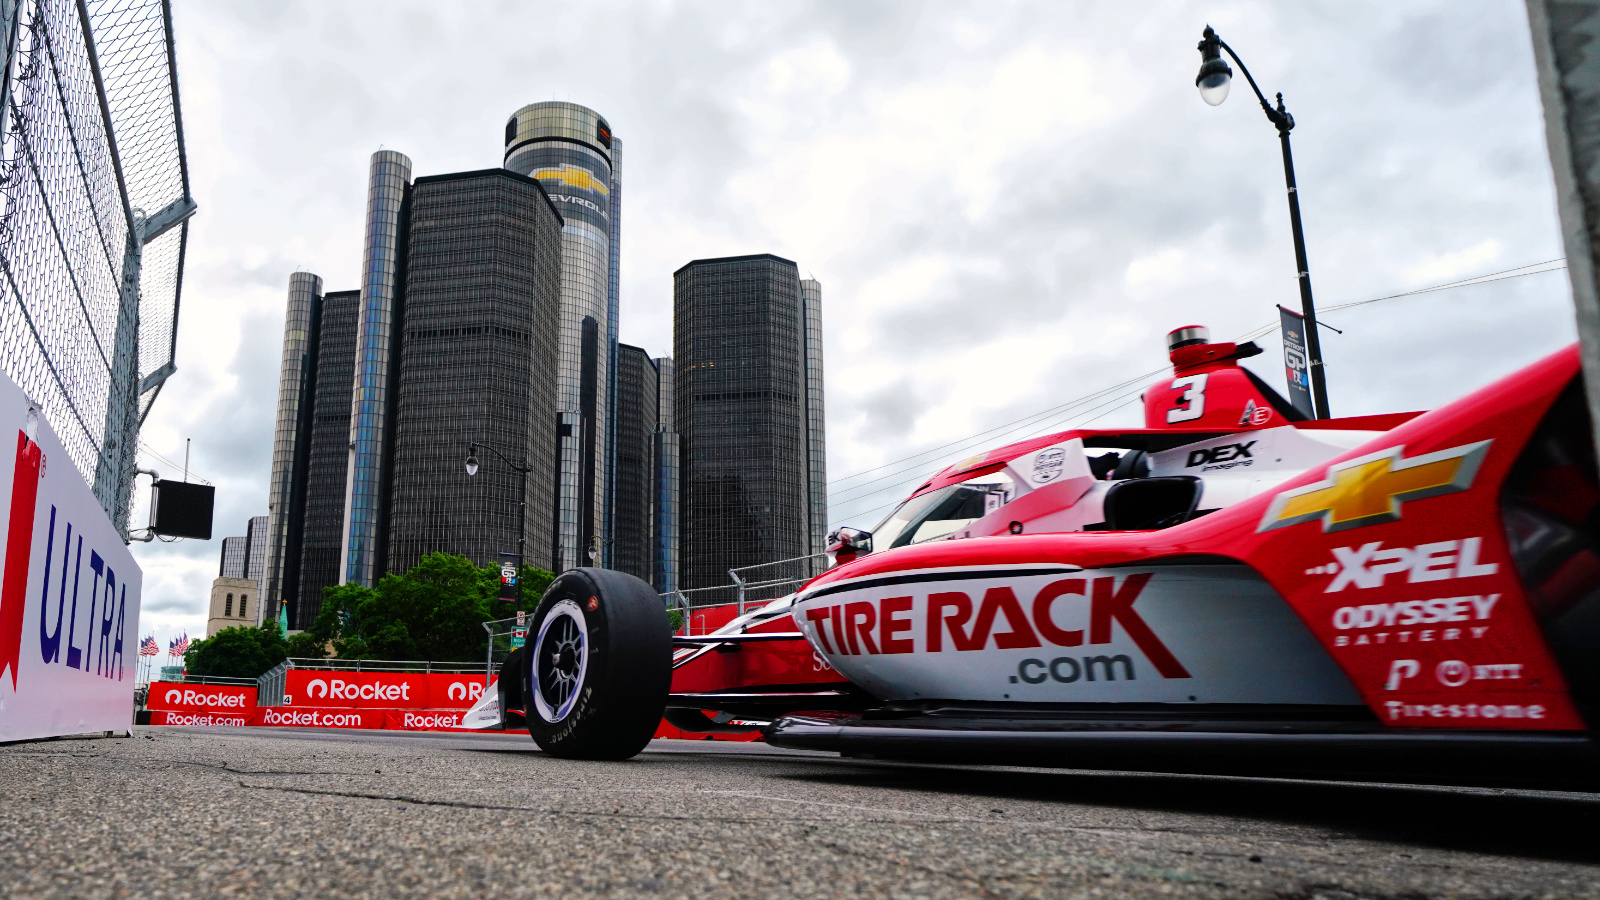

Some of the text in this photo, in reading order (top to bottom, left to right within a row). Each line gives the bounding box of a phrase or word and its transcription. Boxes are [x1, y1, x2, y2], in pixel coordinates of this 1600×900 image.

[1284, 347, 1306, 371] GP
[1166, 373, 1209, 424] 3
[1185, 440, 1259, 468] DEX
[1324, 537, 1499, 593] XPEL
[40, 504, 125, 682] ULTRA
[1333, 593, 1502, 629] ODYSSEY
[806, 573, 1192, 679] TIRE RACK
[1334, 626, 1489, 647] BATTERY
[1009, 654, 1135, 684] .com
[183, 690, 246, 707] Rocket
[283, 696, 291, 706] 4
[330, 680, 410, 700] Rocket
[166, 712, 245, 727] Rocket.com
[264, 709, 361, 726] Rocket.com
[1384, 700, 1547, 720] Firestone
